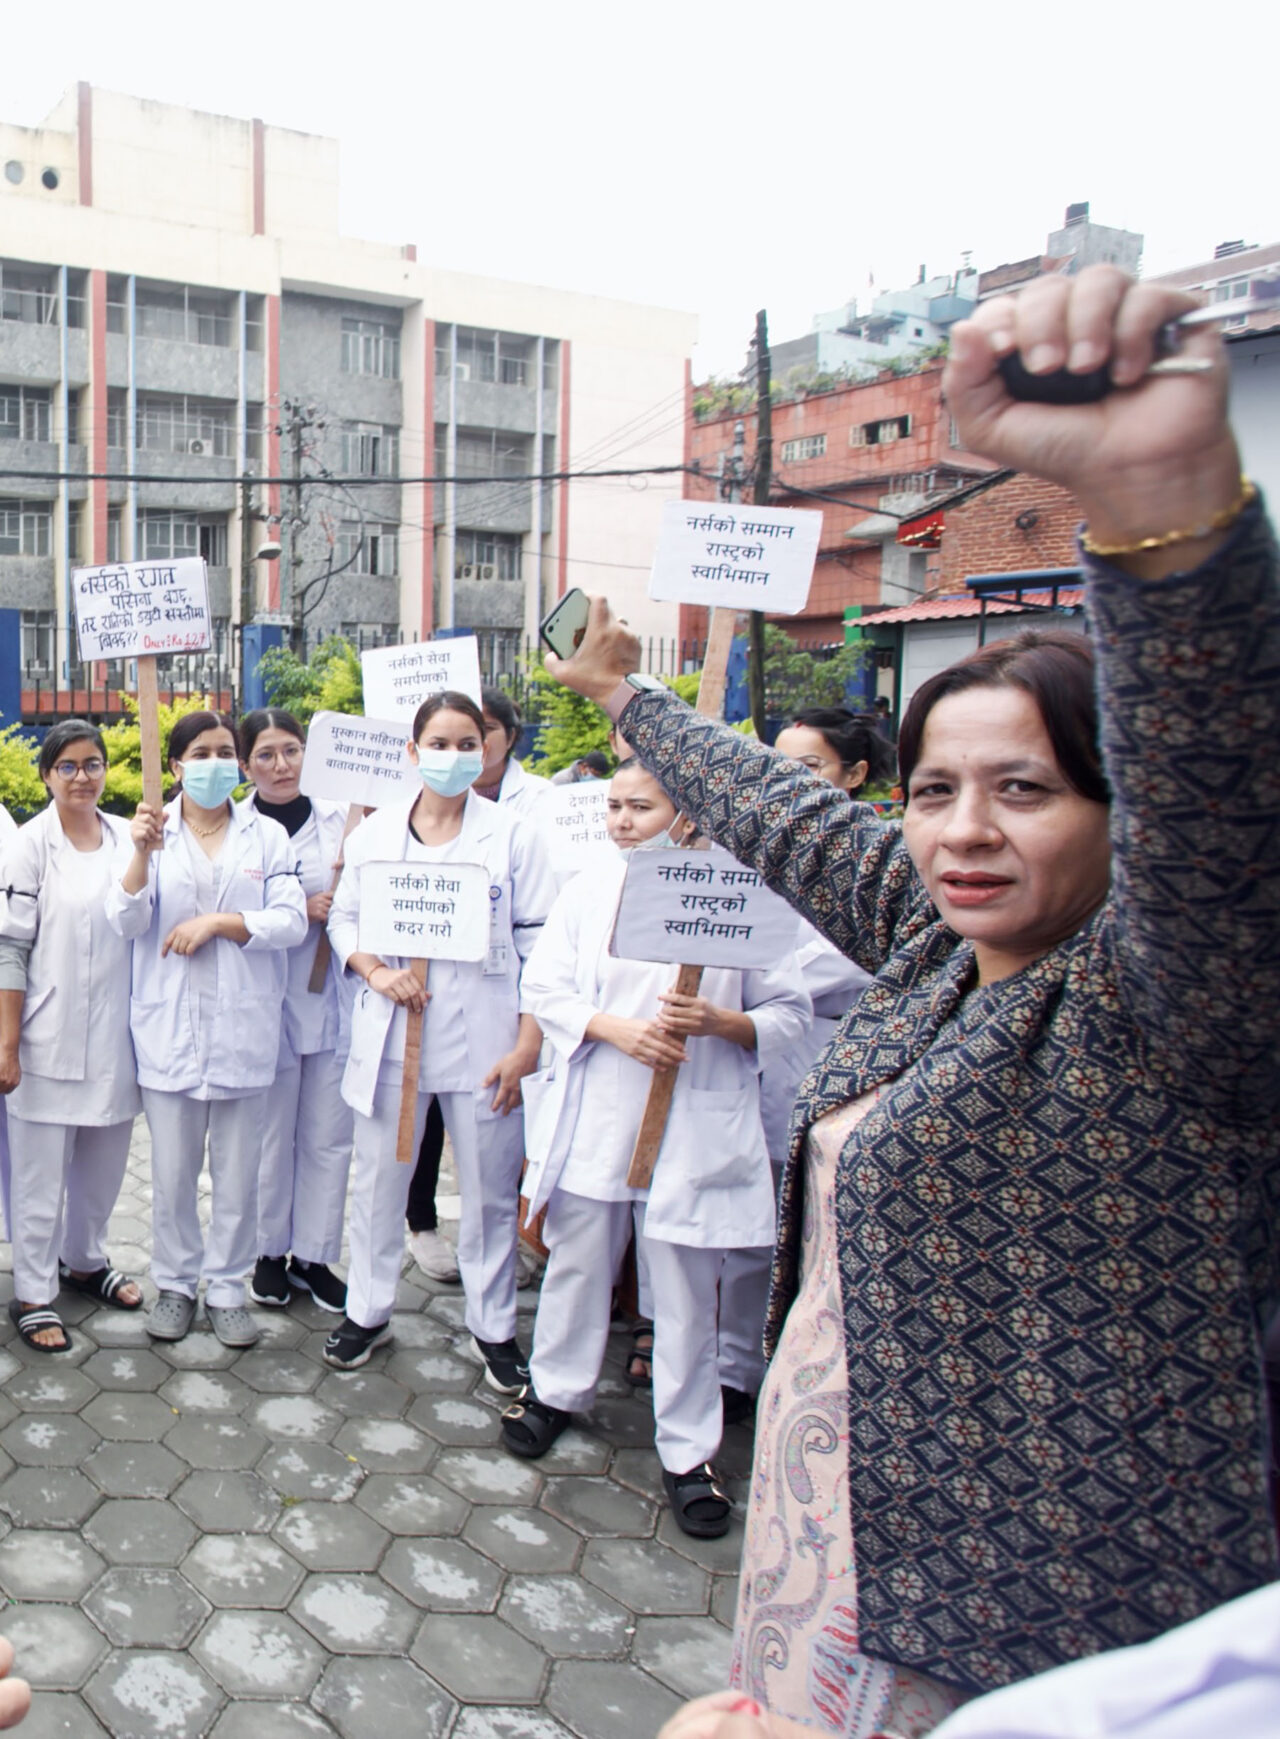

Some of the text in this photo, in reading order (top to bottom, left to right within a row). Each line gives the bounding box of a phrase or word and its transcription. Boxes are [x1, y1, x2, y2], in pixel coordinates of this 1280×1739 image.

[686, 513, 796, 540] नर्सको सम्मान
[706, 542, 765, 562] रास्ट्रको
[80, 566, 130, 594] नर्सको
[691, 562, 770, 585] स्वाभिमान
[81, 616, 98, 634] तर
[386, 650, 451, 669] नर्सको सेवा
[392, 667, 448, 687] समर्पणको
[395, 694, 422, 705] कदर
[331, 725, 367, 741] मुस्कान
[334, 740, 354, 755] सेवा
[389, 873, 461, 893] नर्सको सेवा
[657, 862, 765, 888] नर्सको सम्मा
[392, 896, 456, 915] समर्पणको
[680, 892, 747, 916] रास्ट्रको
[394, 920, 424, 935] कदर
[664, 918, 753, 941] स्वाभिमान
